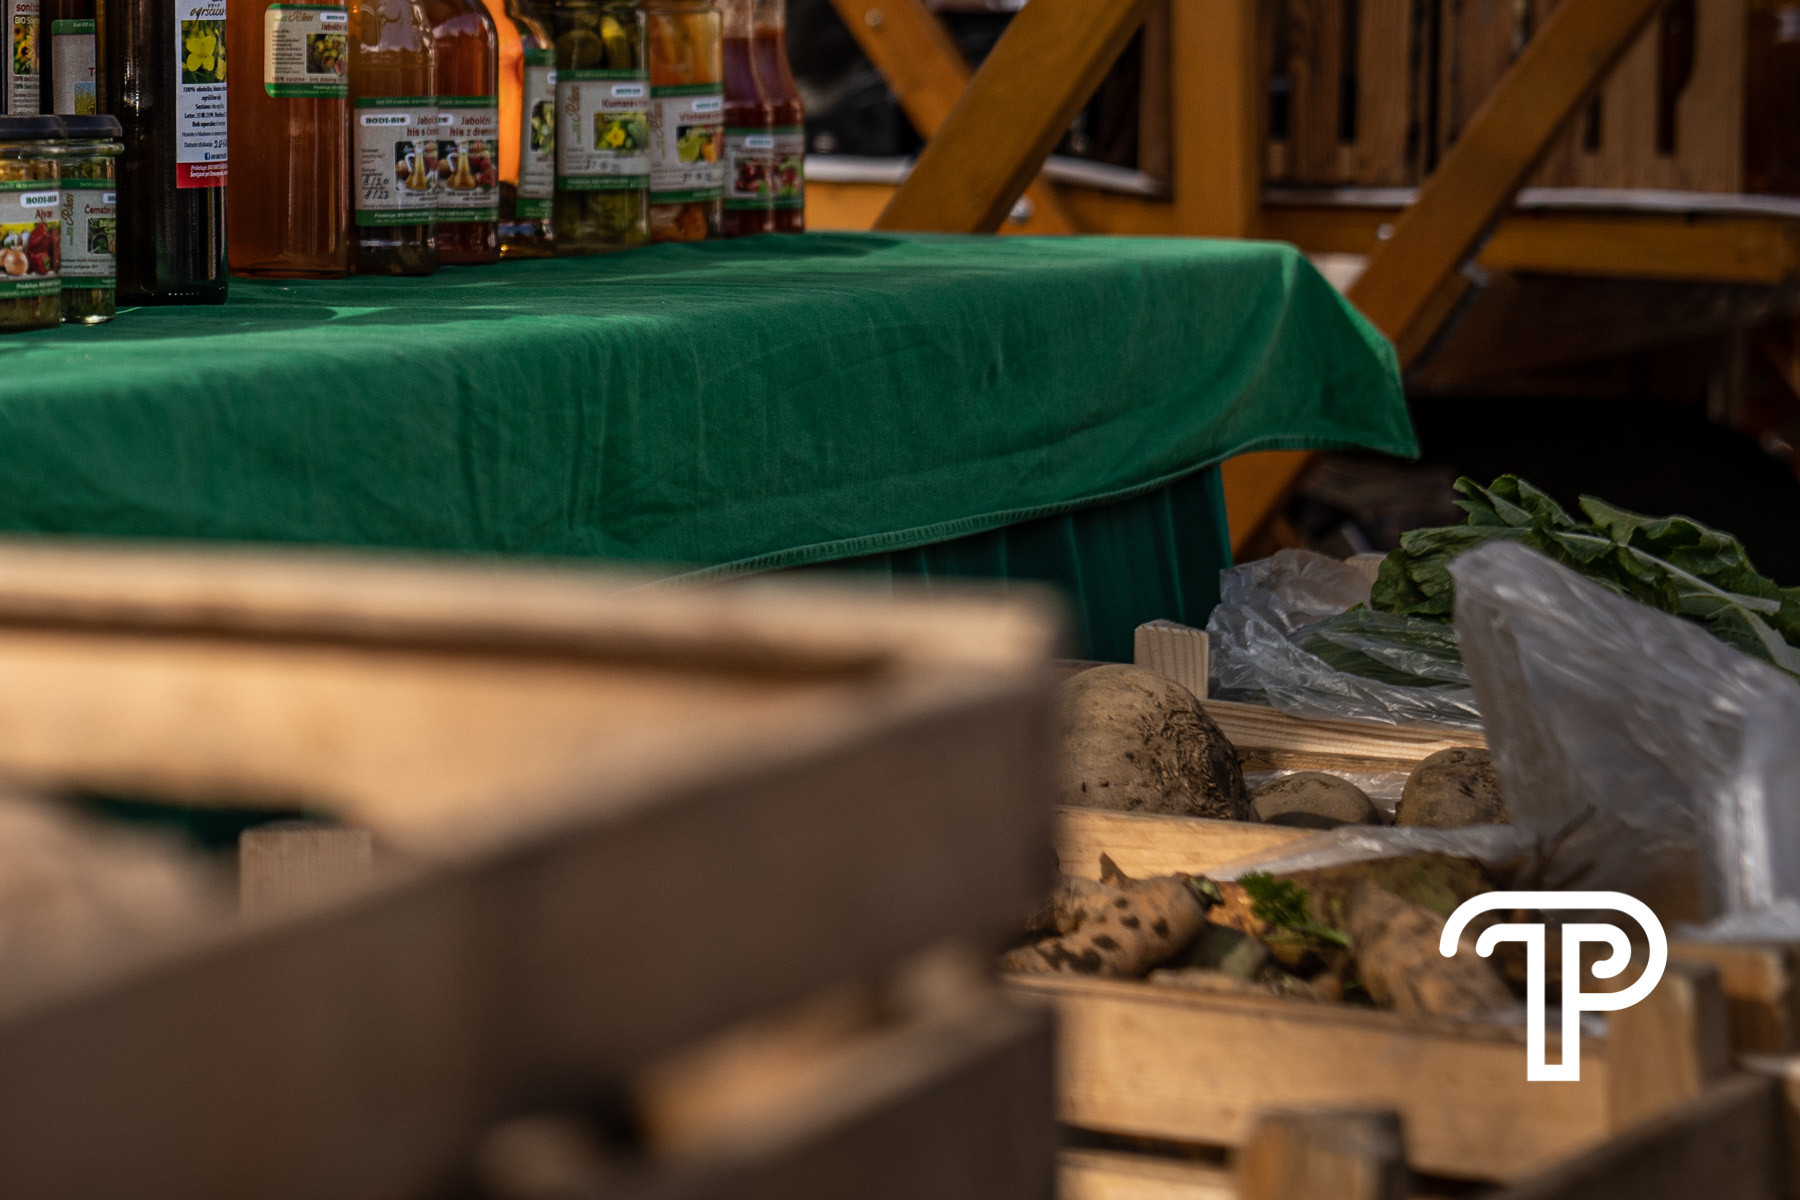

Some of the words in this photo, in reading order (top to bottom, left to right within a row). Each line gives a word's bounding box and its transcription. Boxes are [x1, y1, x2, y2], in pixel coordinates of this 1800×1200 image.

[365, 116, 406, 125] BODI-BIO
[406, 127, 420, 137] kis
[34, 209, 53, 220] Ajvar
